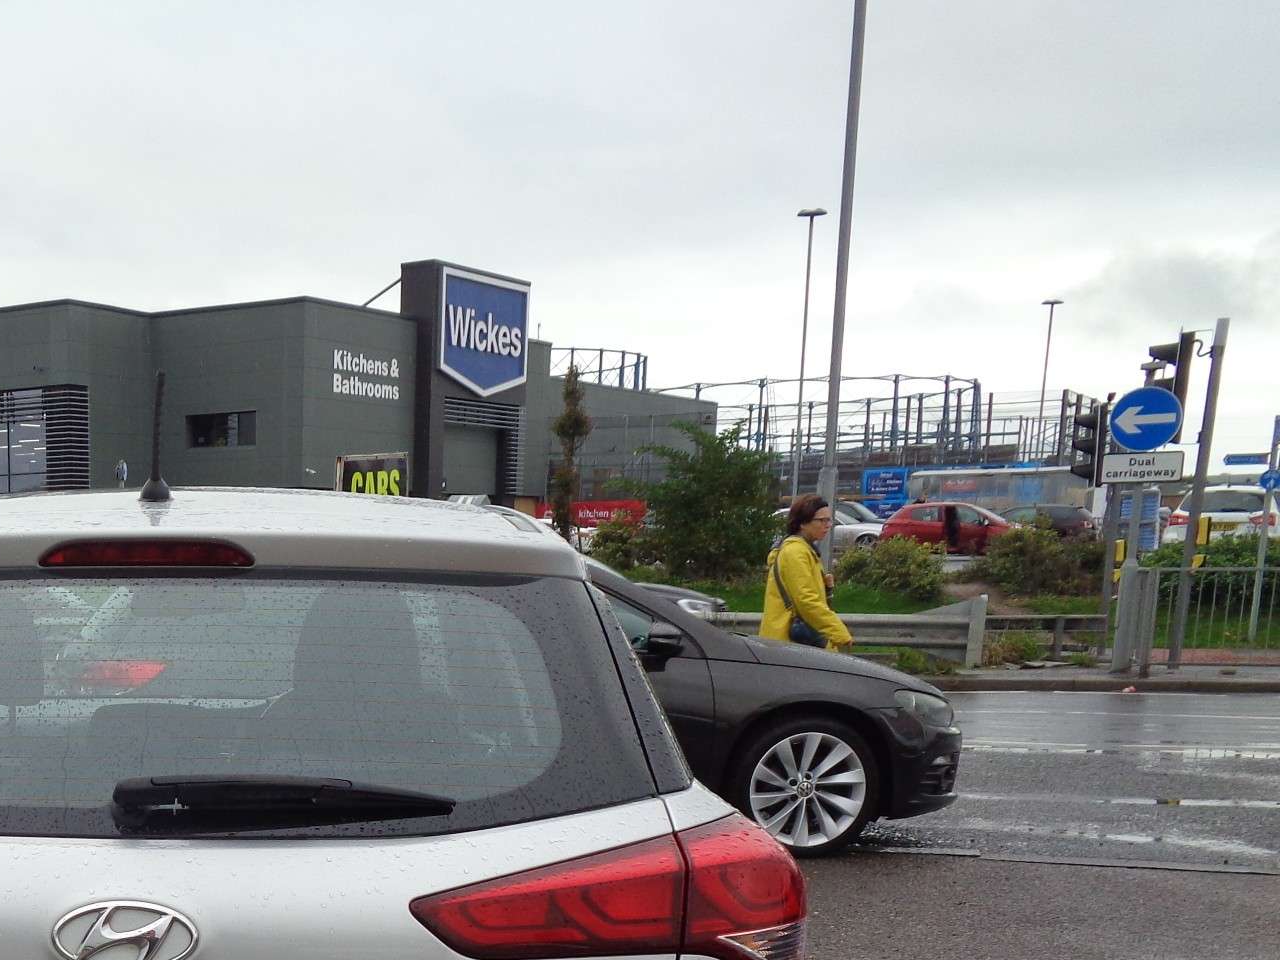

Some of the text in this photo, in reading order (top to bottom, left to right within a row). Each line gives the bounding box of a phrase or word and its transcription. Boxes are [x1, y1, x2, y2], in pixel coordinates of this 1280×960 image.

[449, 304, 521, 357] Wickes
[333, 349, 399, 378] Kitchens &
[333, 374, 400, 400] Bathrooms
[1106, 468, 1176, 478] carriageway
[1129, 457, 1155, 466] Dual
[351, 469, 400, 496] CARS
